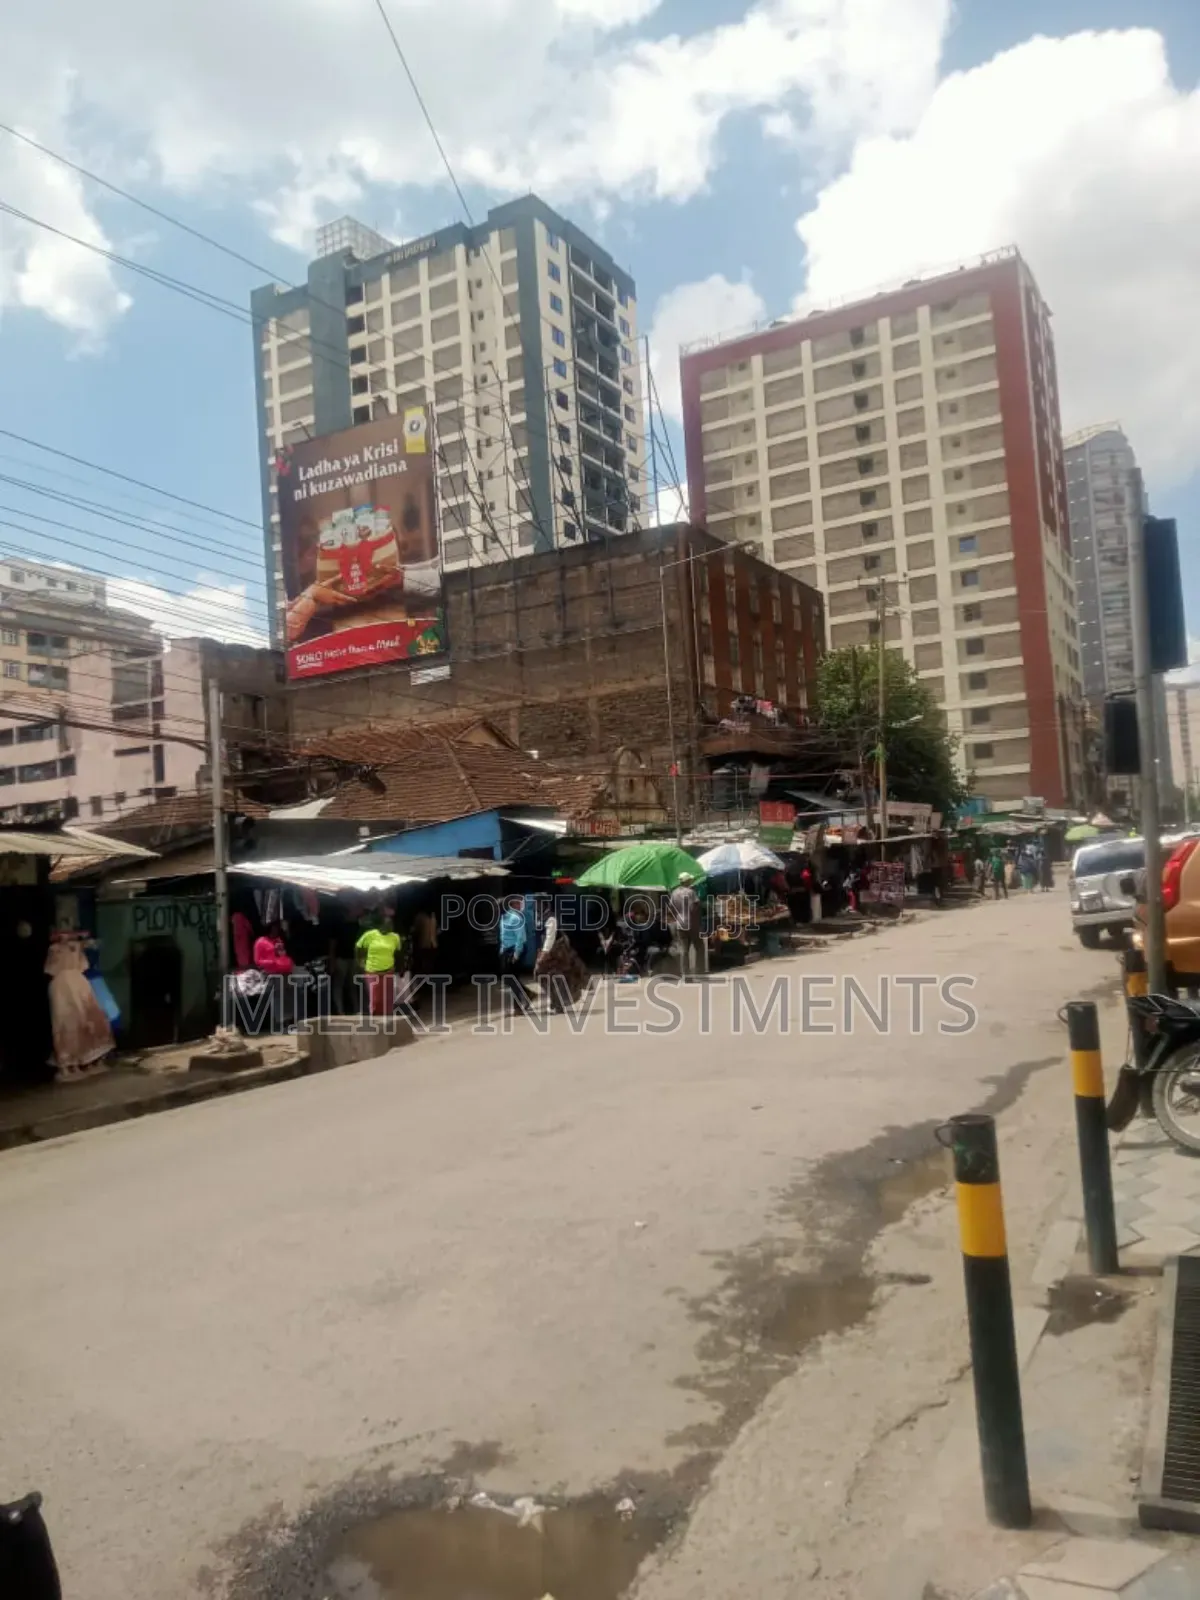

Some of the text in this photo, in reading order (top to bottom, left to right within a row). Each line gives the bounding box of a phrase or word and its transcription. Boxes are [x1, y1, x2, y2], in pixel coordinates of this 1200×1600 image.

[294, 460, 408, 501] ni kuzawadiana
[299, 438, 398, 481] Ladha ya Krisi
